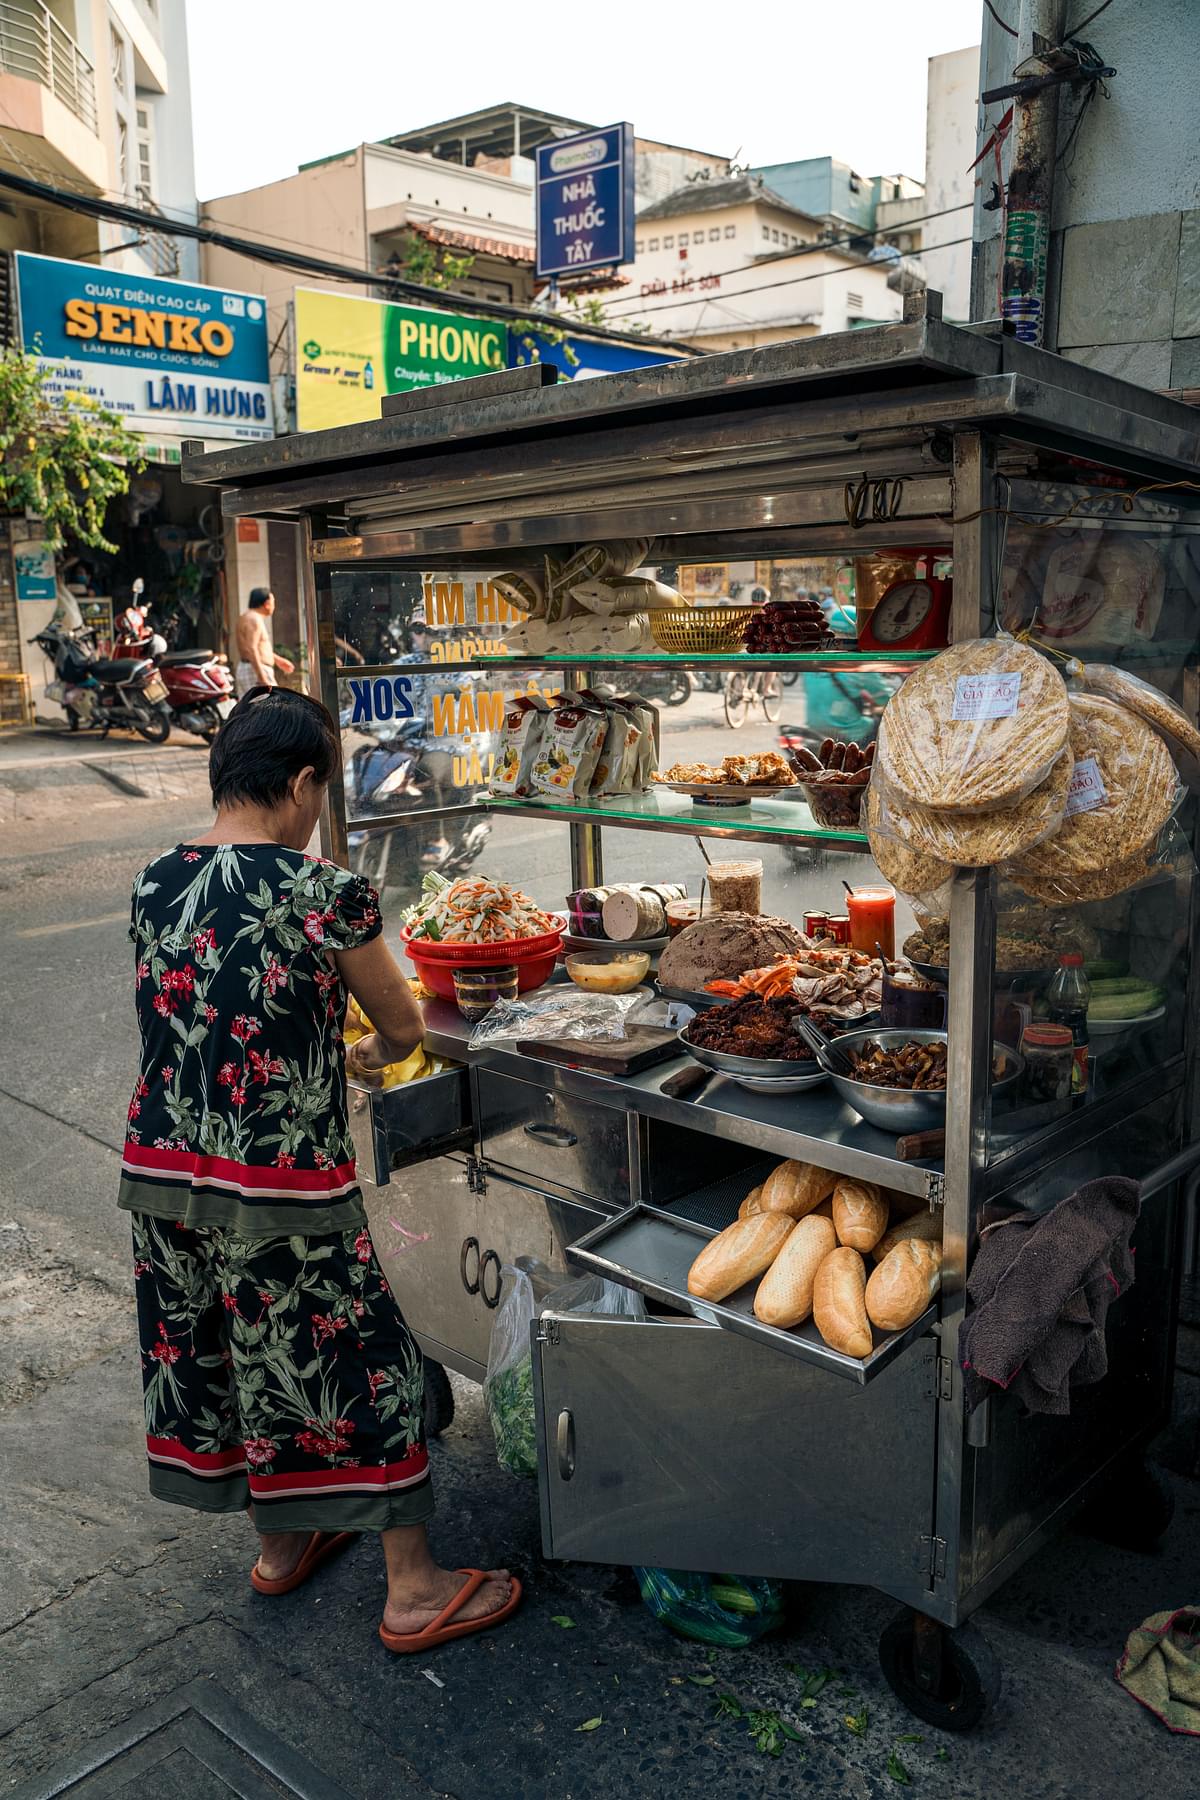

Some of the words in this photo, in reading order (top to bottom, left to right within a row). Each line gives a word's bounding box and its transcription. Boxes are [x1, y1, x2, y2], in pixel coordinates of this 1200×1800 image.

[562, 174, 596, 203] NHÀ
[553, 200, 606, 236] THUỐC
[565, 238, 594, 264] TÂY
[84, 283, 122, 300] QUẠT
[123, 288, 155, 305] ĐIỆN
[156, 295, 184, 310] CAO
[65, 299, 234, 357] SENKO
[400, 319, 502, 367] PHONG
[147, 375, 197, 412] LÂM
[206, 386, 266, 420] HƯNG
